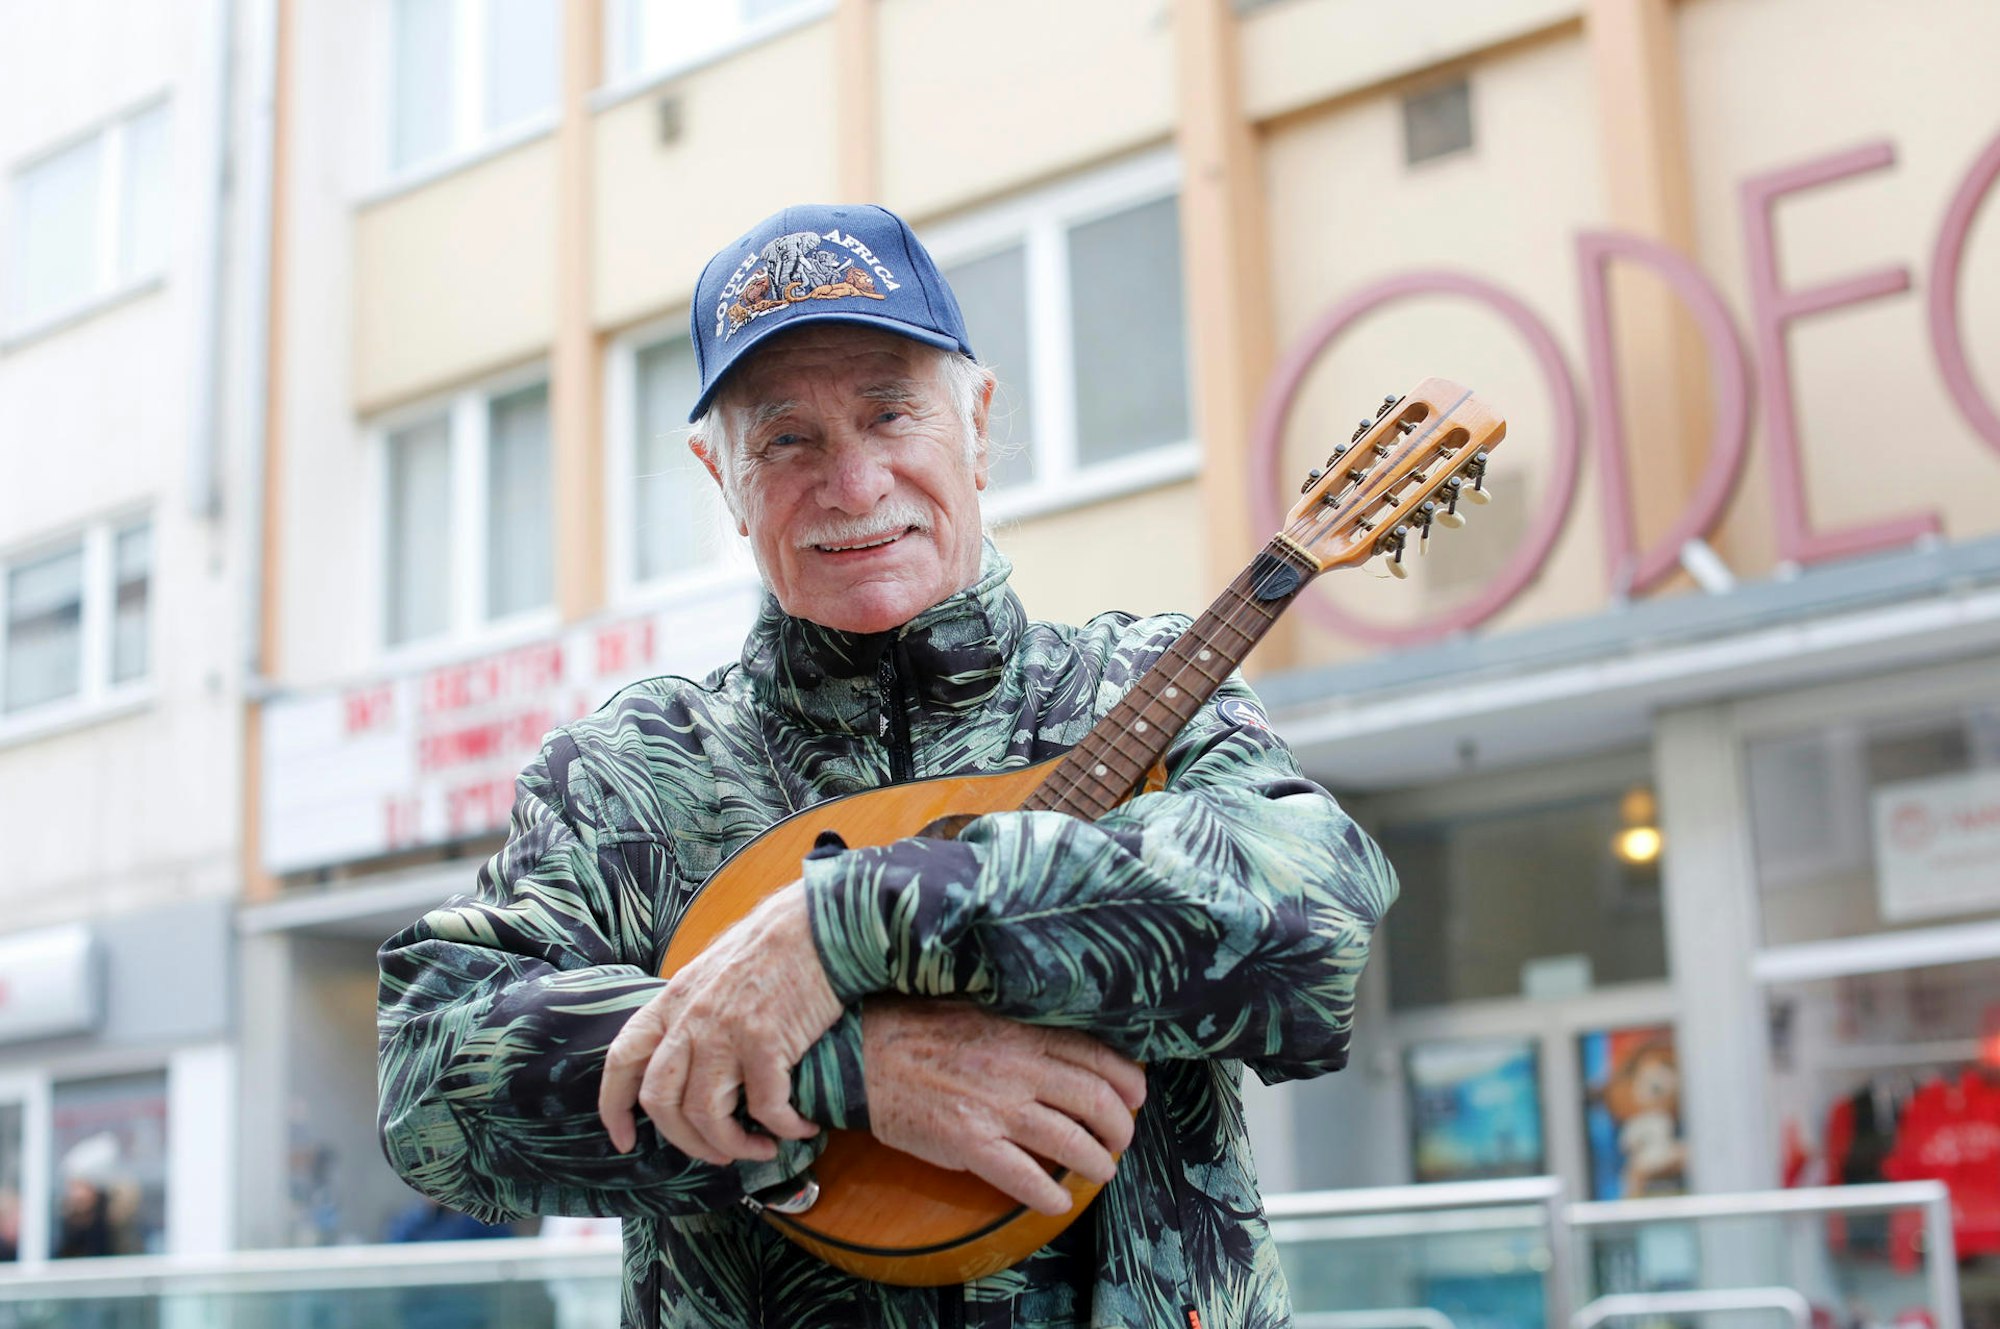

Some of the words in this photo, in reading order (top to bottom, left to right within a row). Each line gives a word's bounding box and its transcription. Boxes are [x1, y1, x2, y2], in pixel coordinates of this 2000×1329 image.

[715, 253, 760, 338] SOUTH
[822, 229, 902, 292] AFRICA
[1252, 127, 2000, 648] ODE
